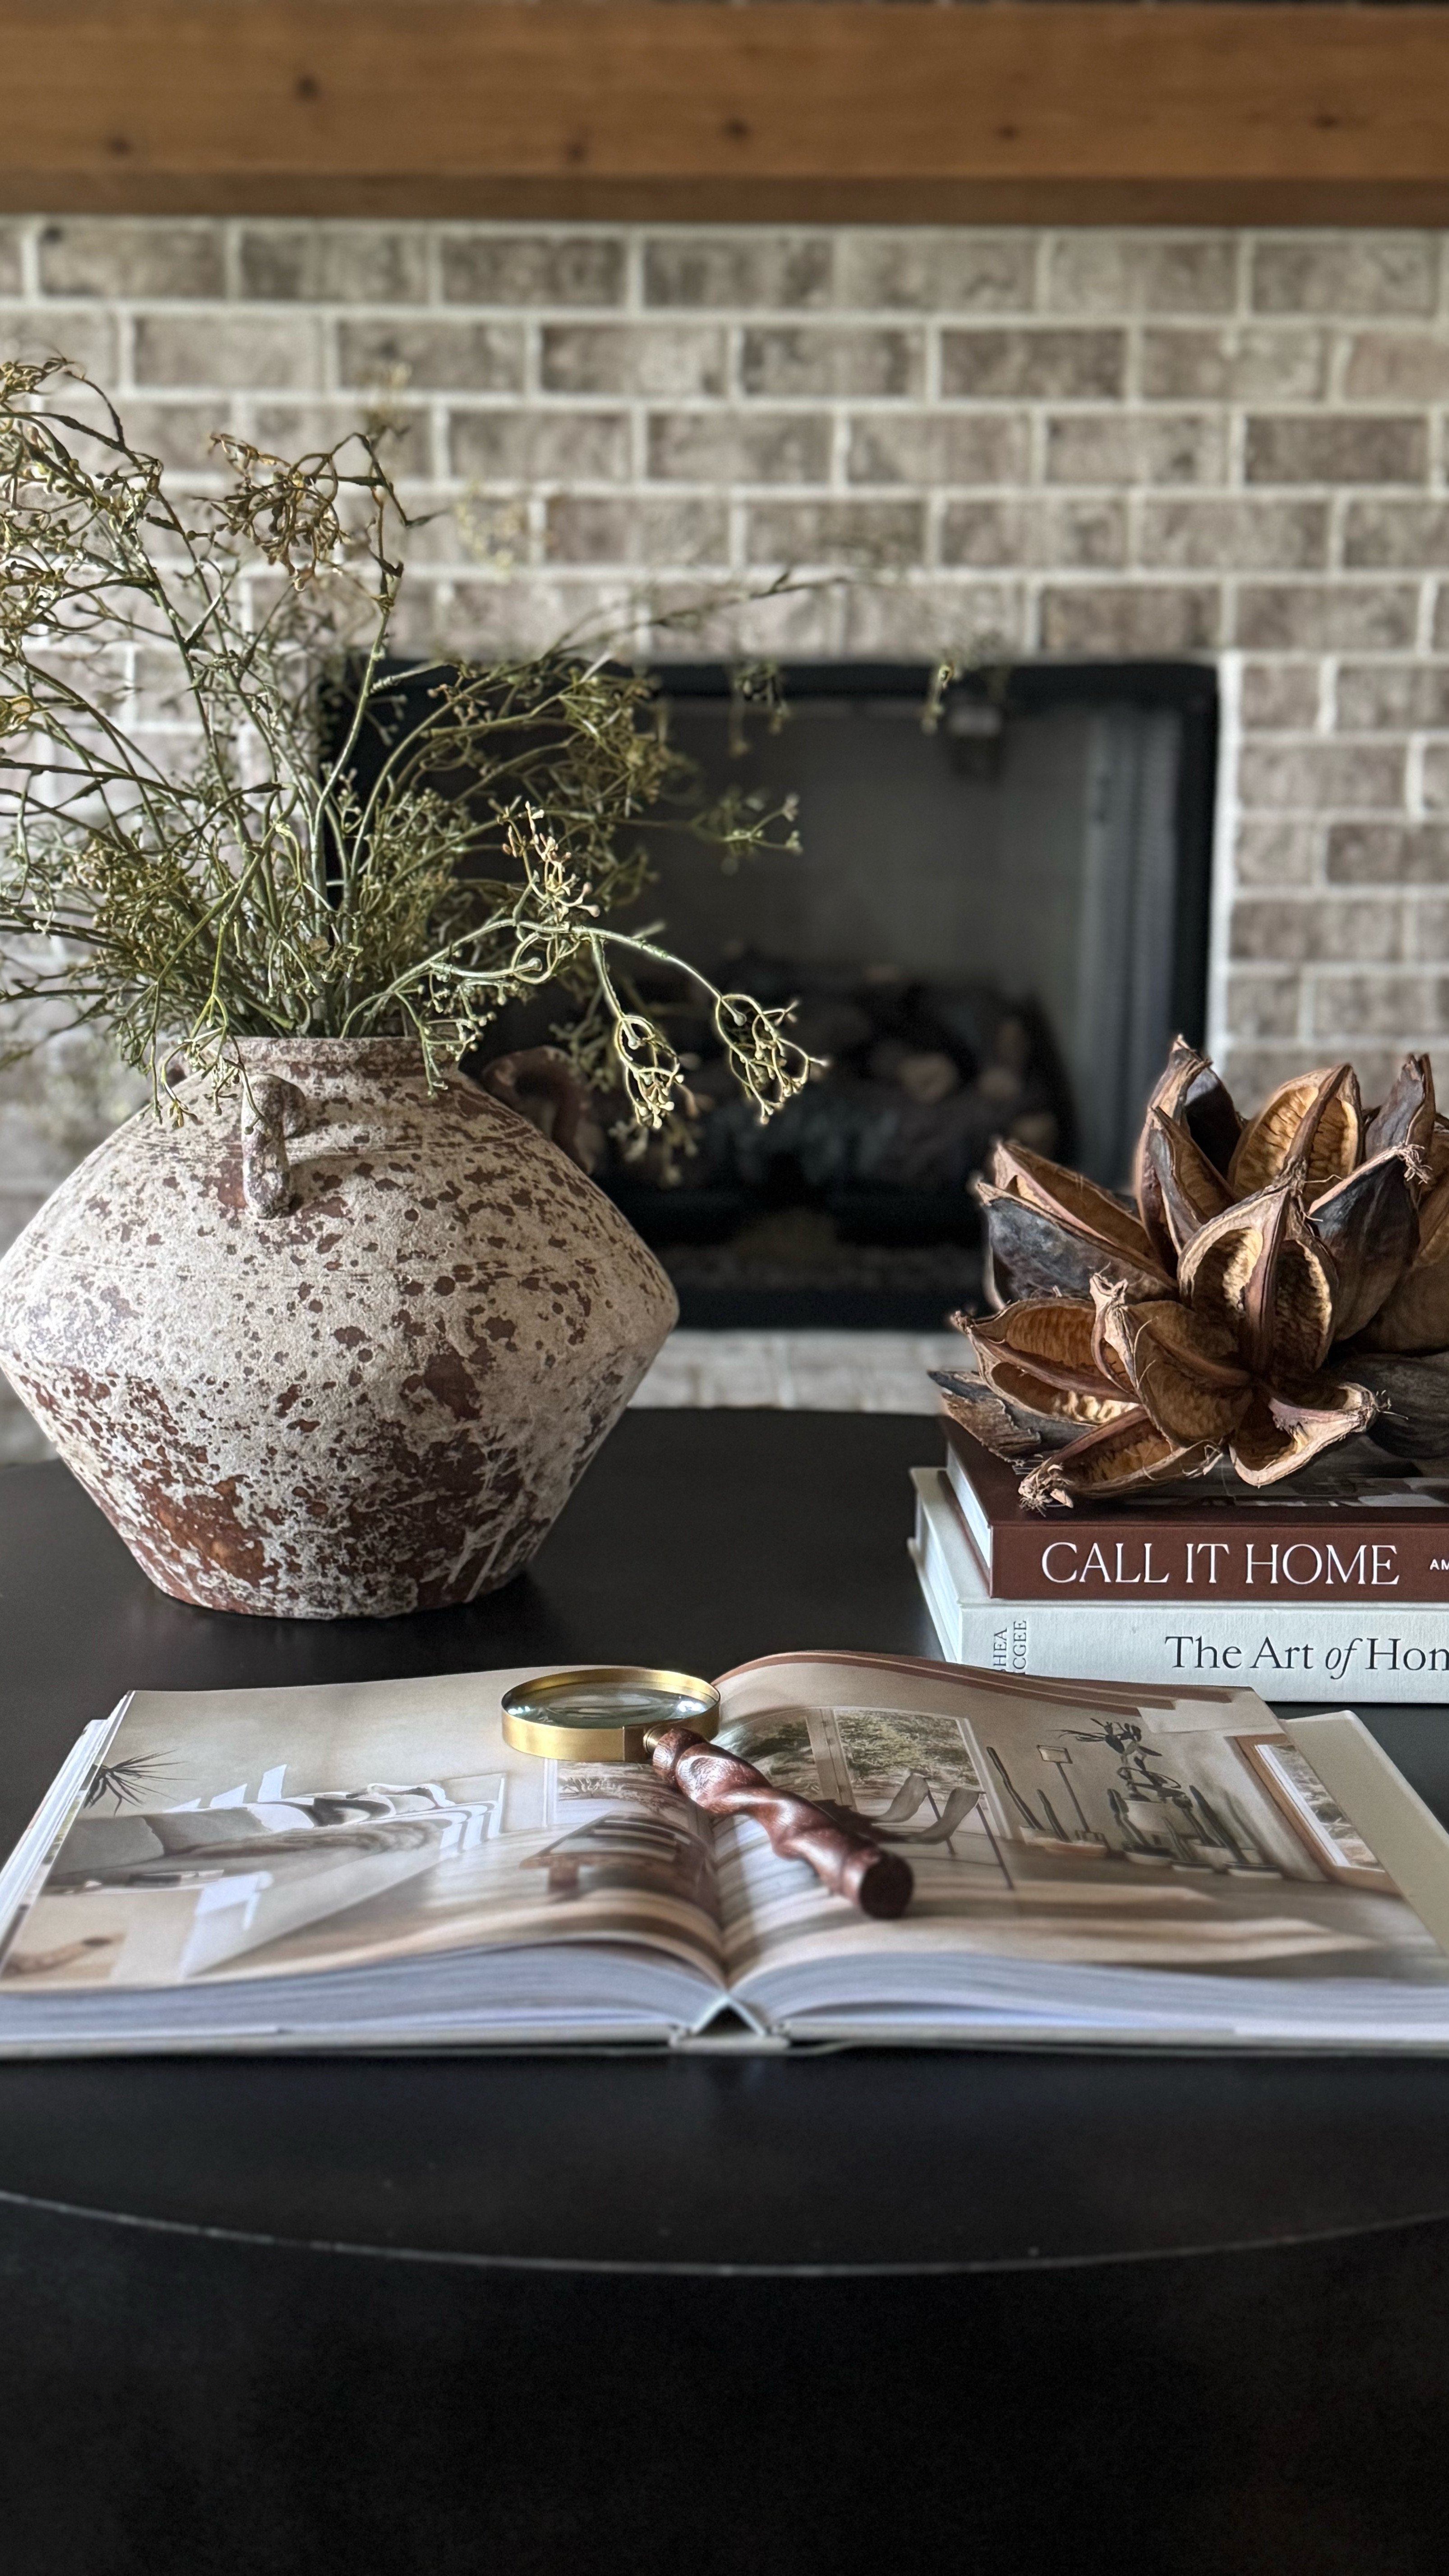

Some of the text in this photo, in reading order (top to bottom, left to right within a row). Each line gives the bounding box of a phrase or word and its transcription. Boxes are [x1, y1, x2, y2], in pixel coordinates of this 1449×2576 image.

[1042, 1542, 1399, 1585] CALL IT HOME
[993, 1627, 1007, 1672] HEA
[1013, 1620, 1027, 1673] CGEE
[1165, 1636, 1242, 1669] The
[1250, 1636, 1314, 1669] Art
[1325, 1638, 1363, 1680] of
